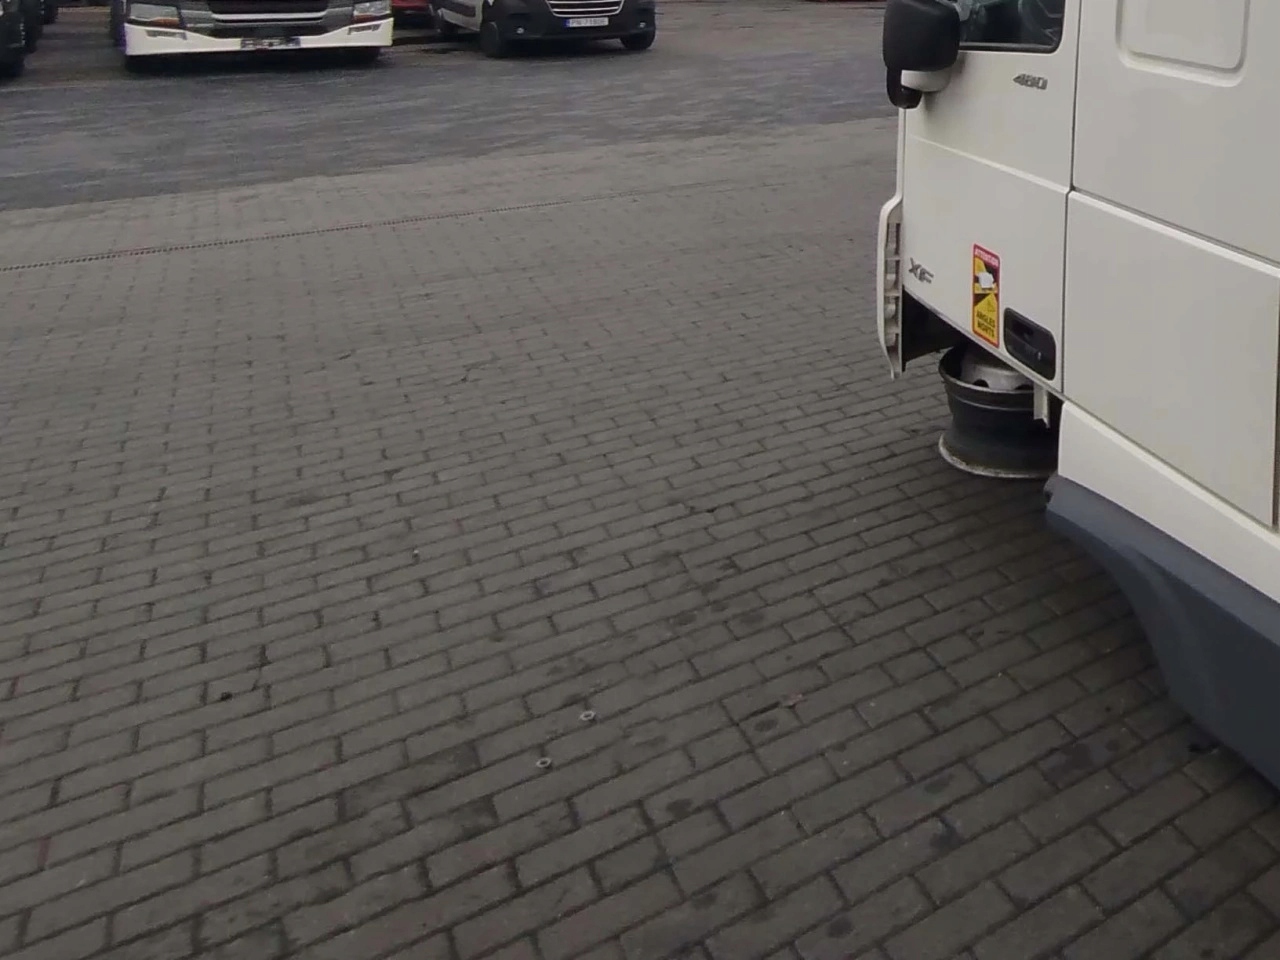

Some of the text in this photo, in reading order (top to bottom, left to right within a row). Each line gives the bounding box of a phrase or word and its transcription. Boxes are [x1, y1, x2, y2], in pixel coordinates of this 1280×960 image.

[908, 256, 934, 284] XF
[976, 310, 996, 328] ANGLES
[977, 319, 995, 338] MORTS
